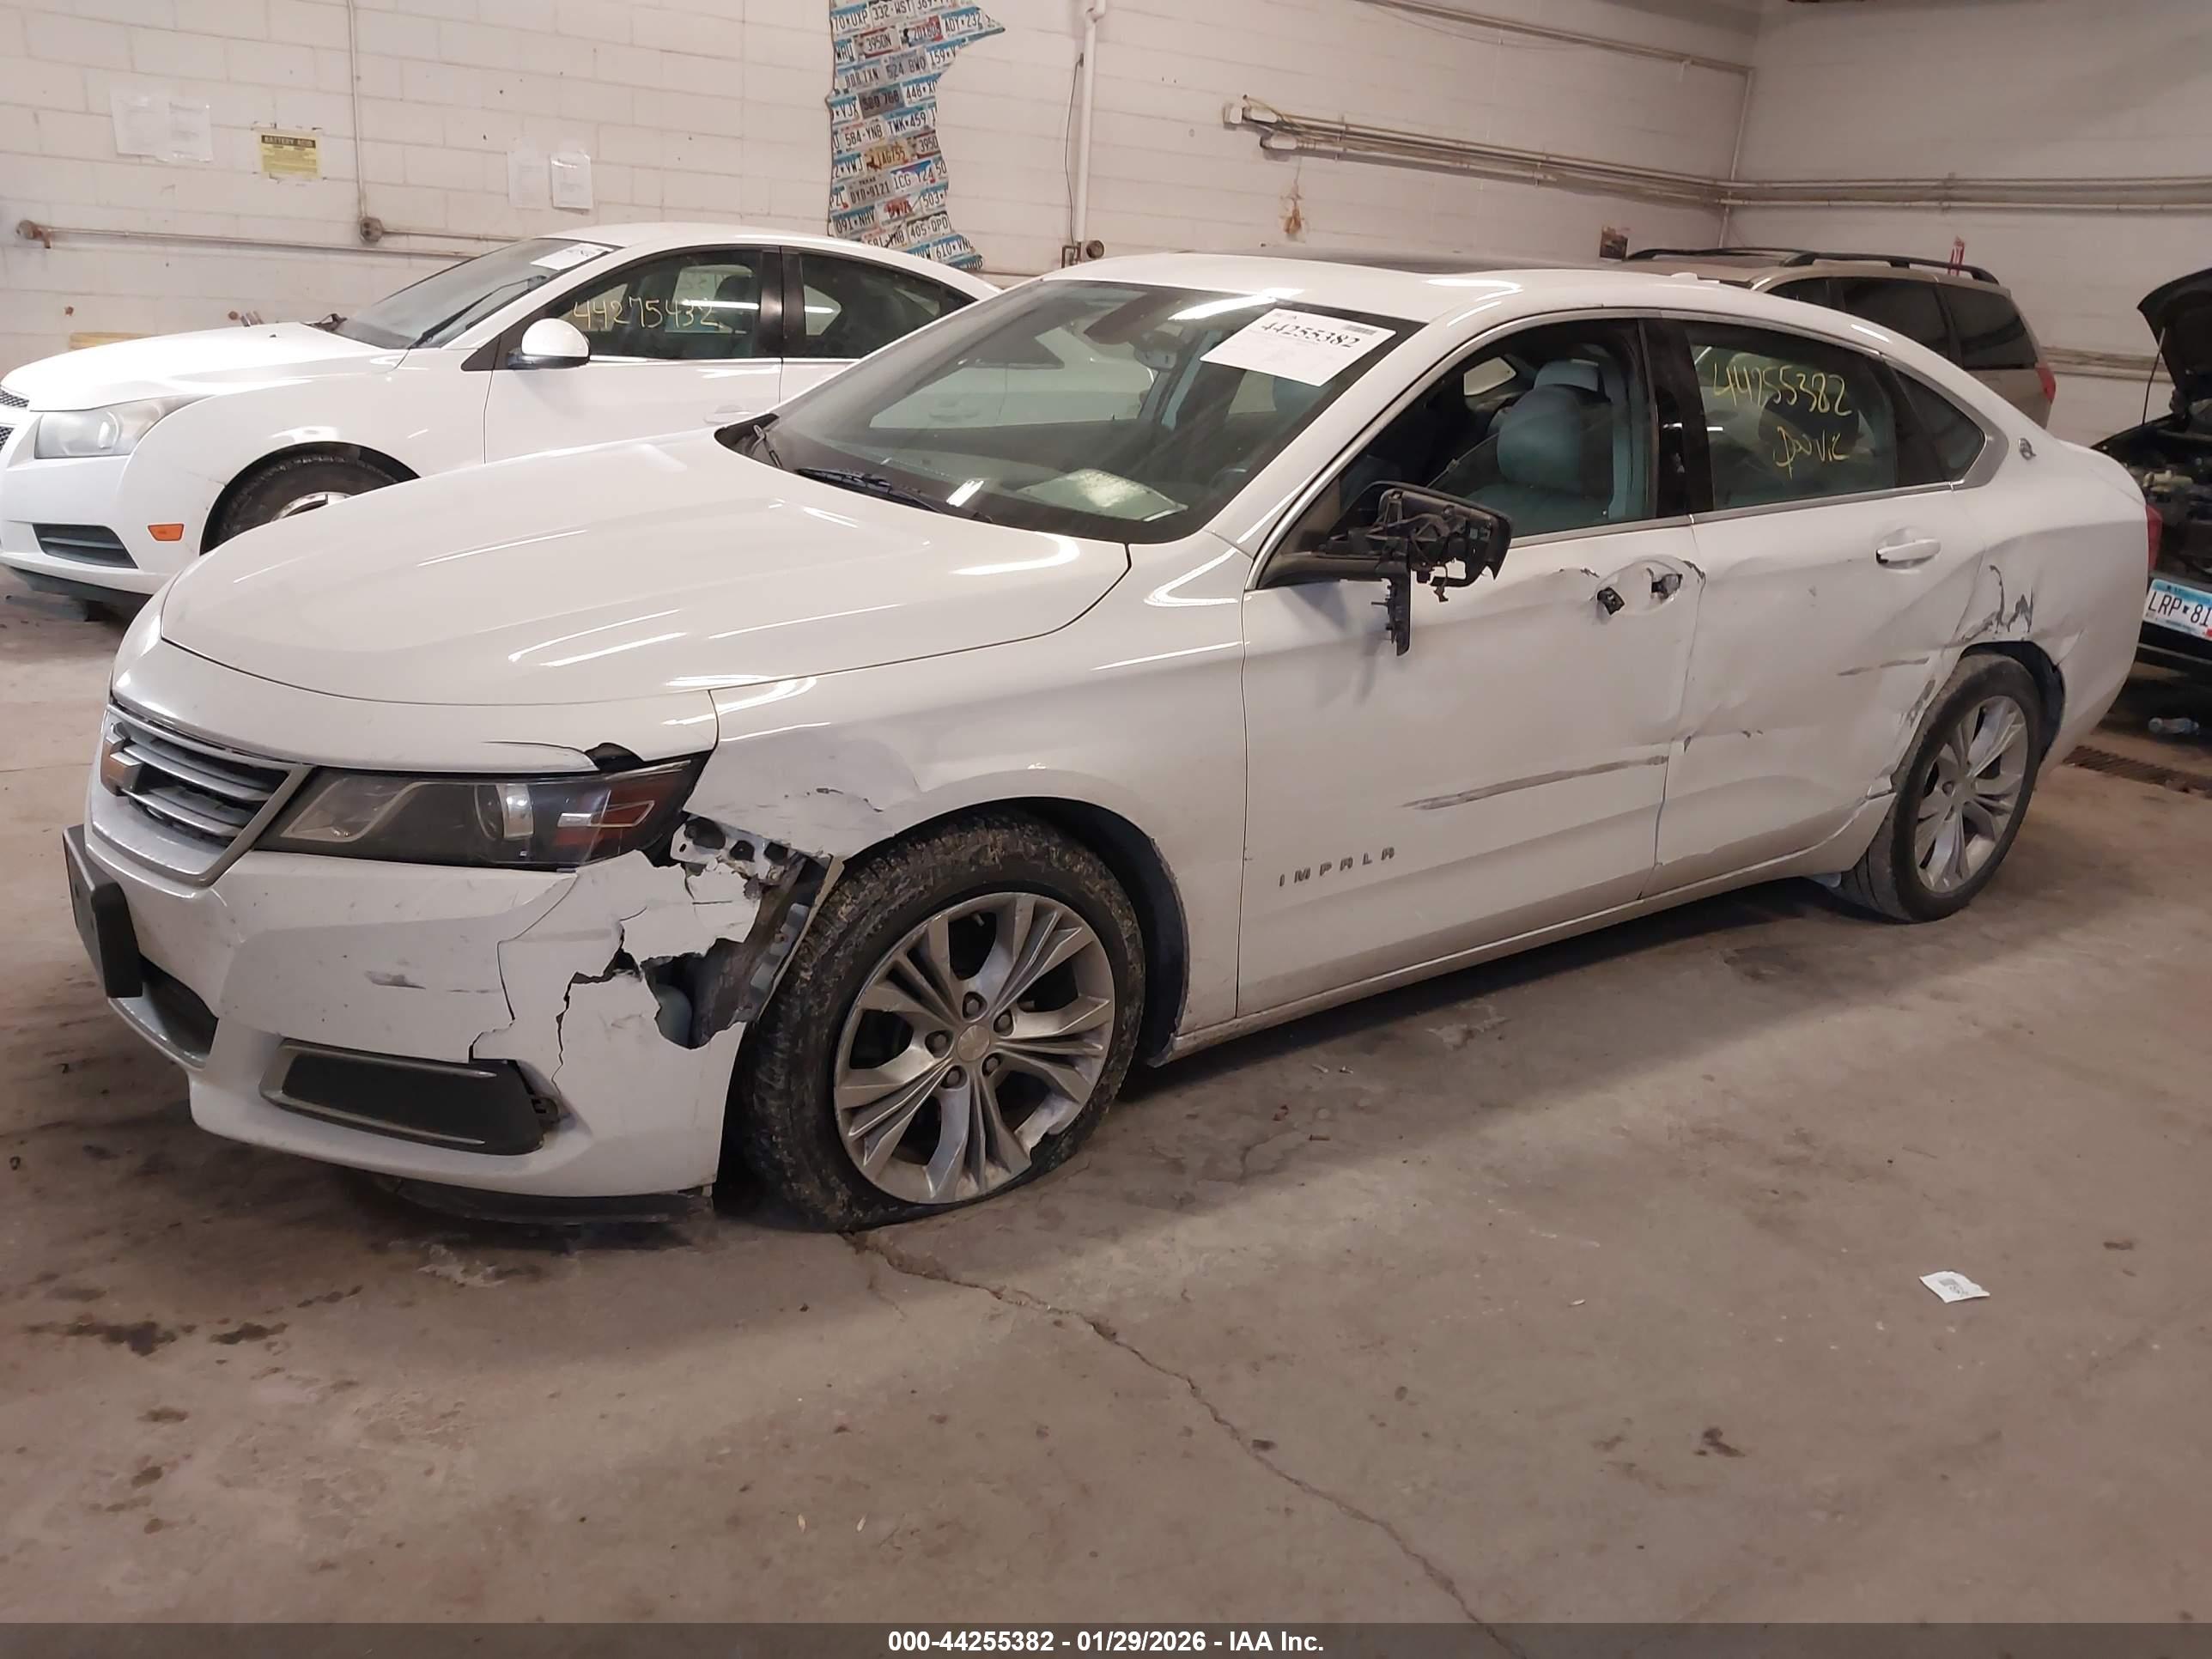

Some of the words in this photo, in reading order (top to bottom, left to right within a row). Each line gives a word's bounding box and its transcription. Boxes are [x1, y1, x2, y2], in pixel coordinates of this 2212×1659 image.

[574, 296, 720, 330] 44275432
[1261, 321, 1362, 349] 44255382
[2148, 590, 2183, 617] LRP
[1279, 847, 1395, 887] IMPALA
